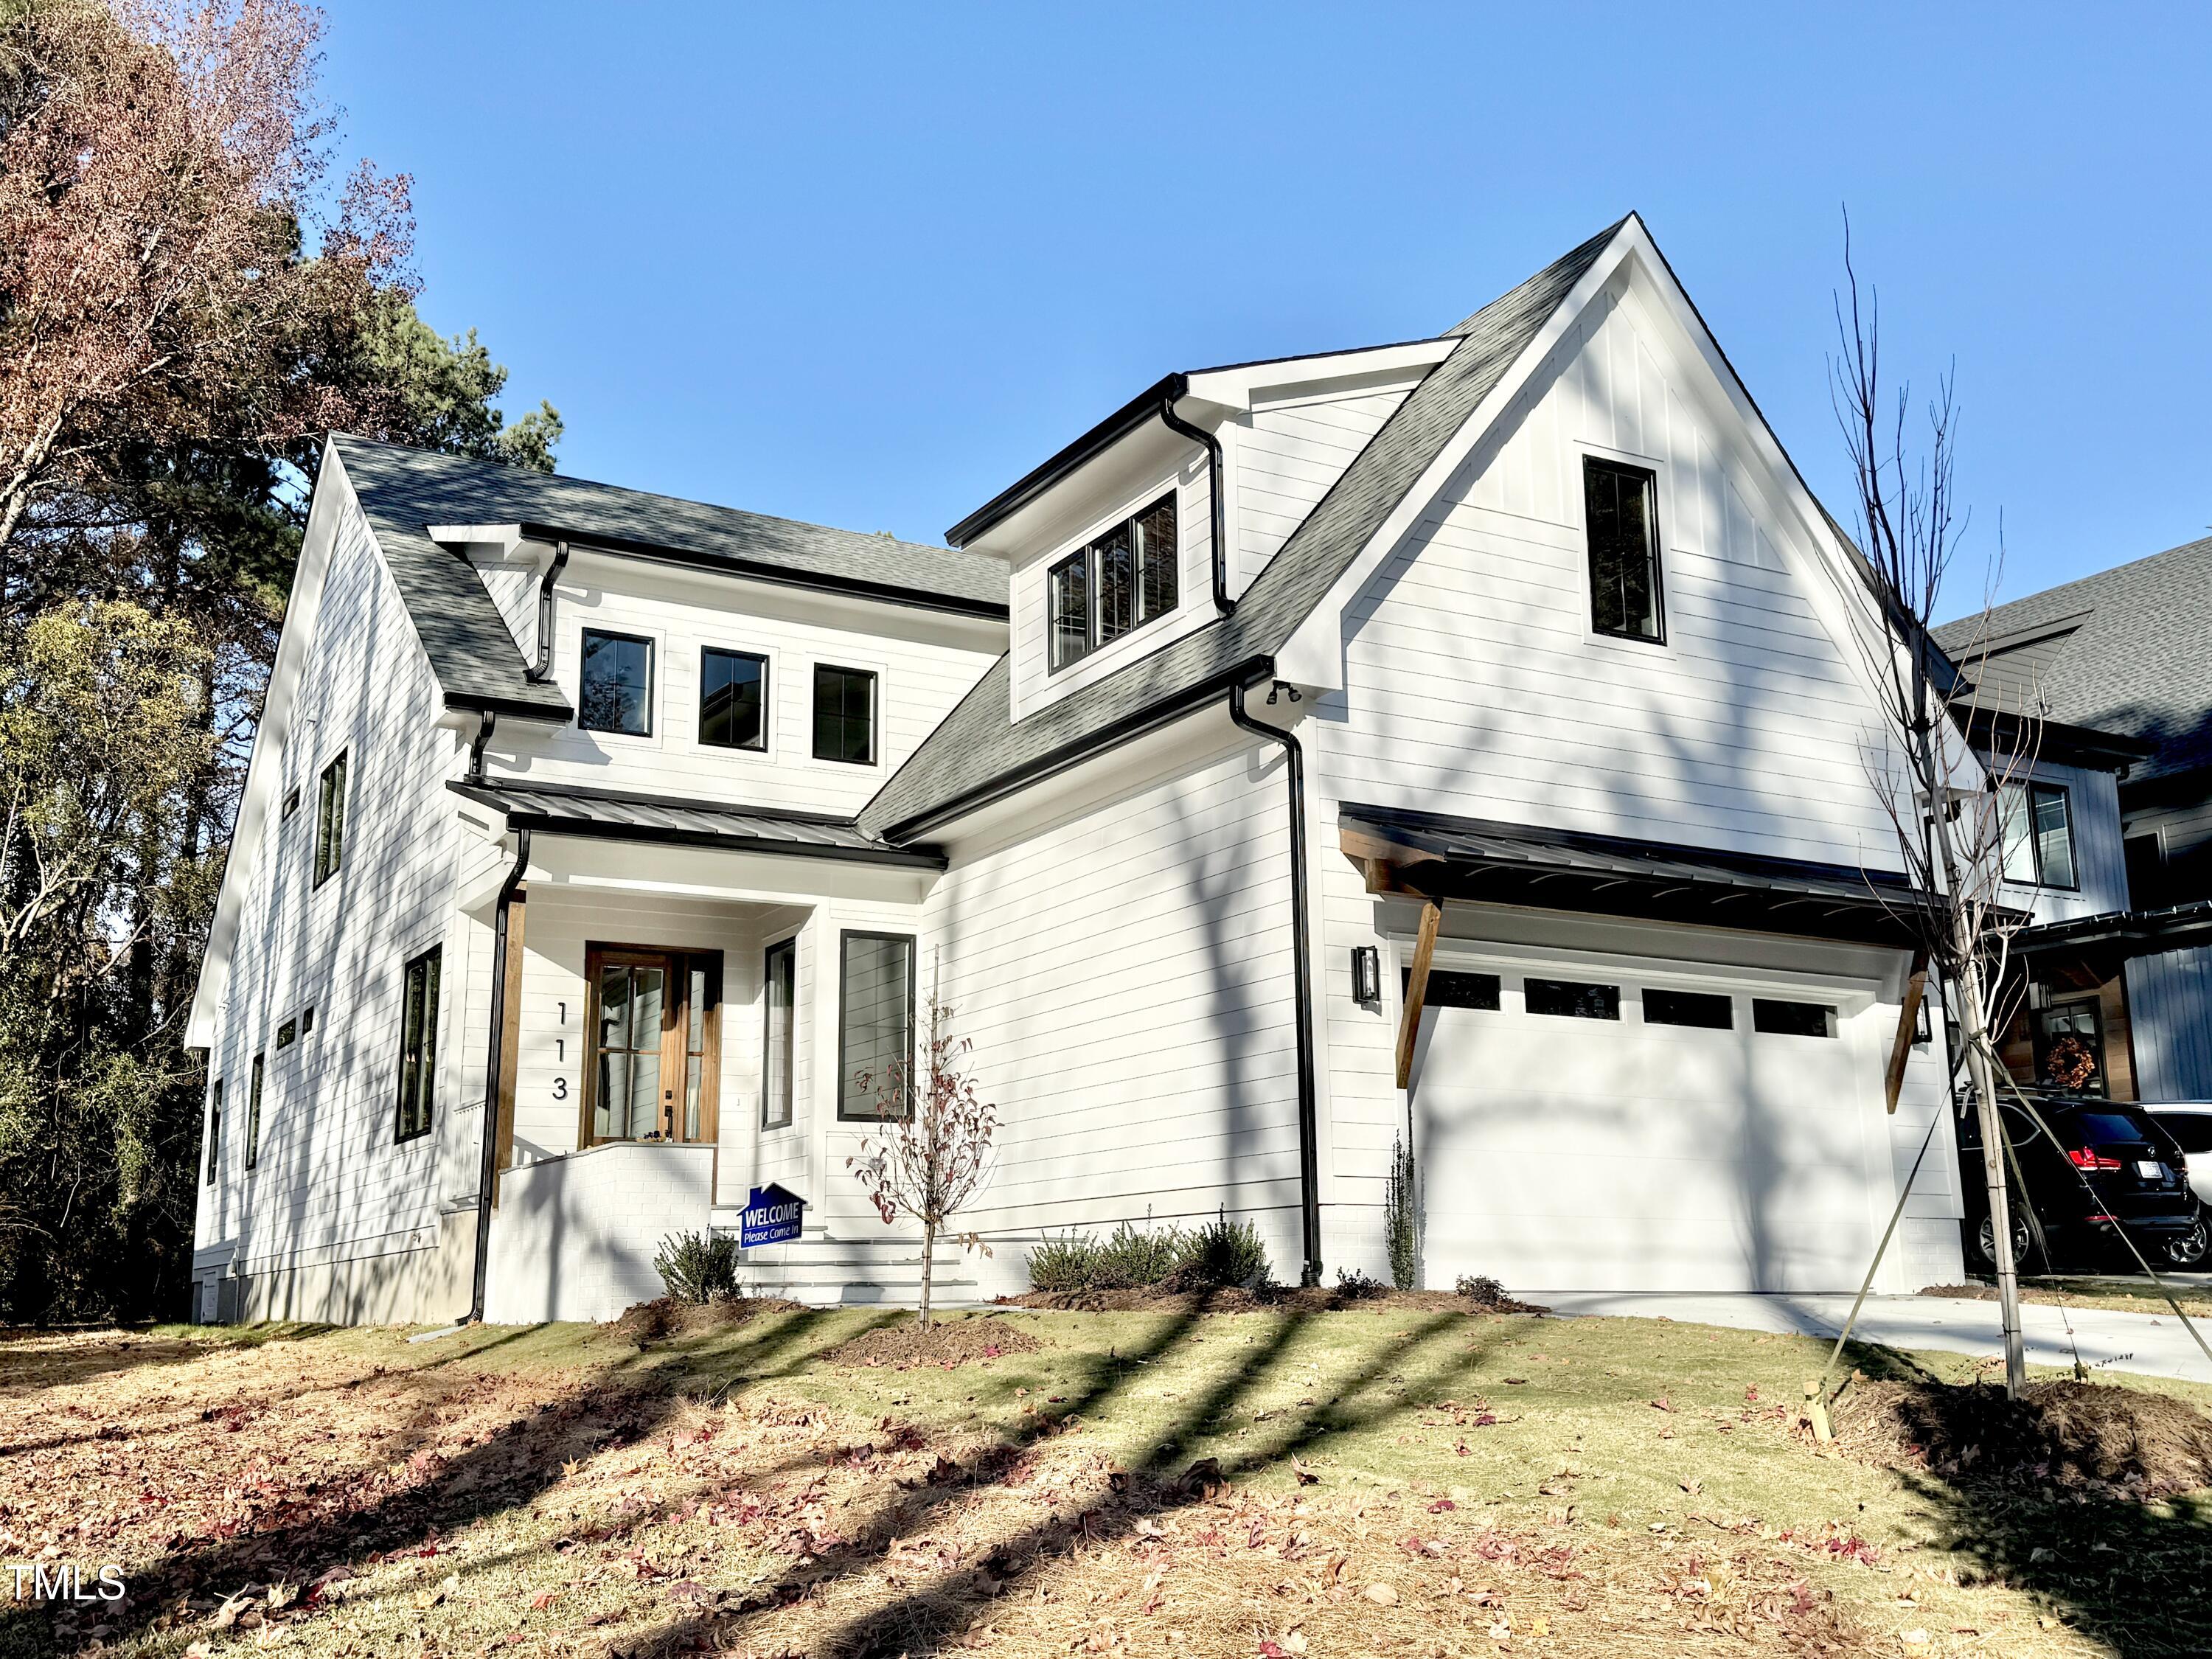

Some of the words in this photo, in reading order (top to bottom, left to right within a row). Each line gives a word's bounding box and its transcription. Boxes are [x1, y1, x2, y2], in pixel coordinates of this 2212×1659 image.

[745, 1202, 799, 1228] WELCOME
[744, 1231, 768, 1244] Please
[769, 1227, 790, 1239] Come
[791, 1224, 799, 1234] In
